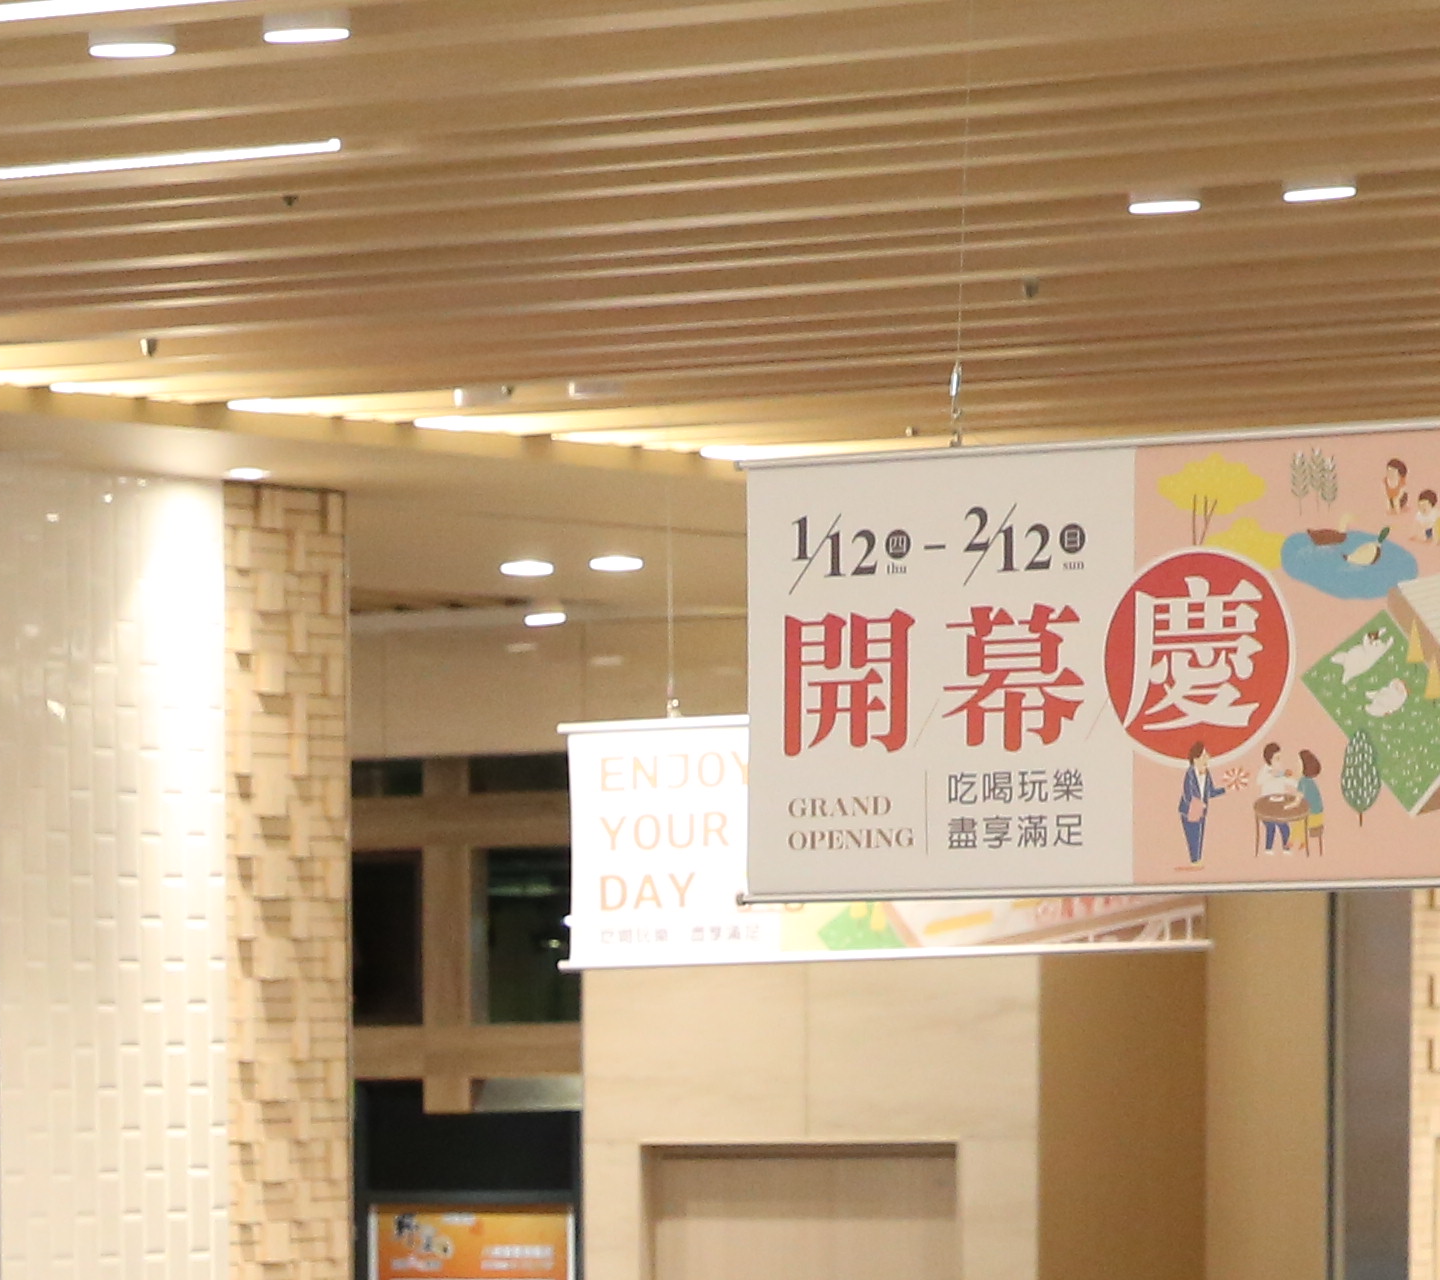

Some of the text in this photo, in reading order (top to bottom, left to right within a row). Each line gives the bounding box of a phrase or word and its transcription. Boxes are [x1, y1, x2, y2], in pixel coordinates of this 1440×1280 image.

[784, 577, 1264, 757] 開幕慶
[600, 751, 750, 792] ENJOY
[947, 768, 1084, 806] 吃喝玩樂
[787, 795, 892, 818] GRAND
[599, 811, 730, 851] YOUR
[788, 827, 915, 851] OPENING
[947, 813, 1083, 850] 盡享滿足
[599, 872, 696, 912] DAY
